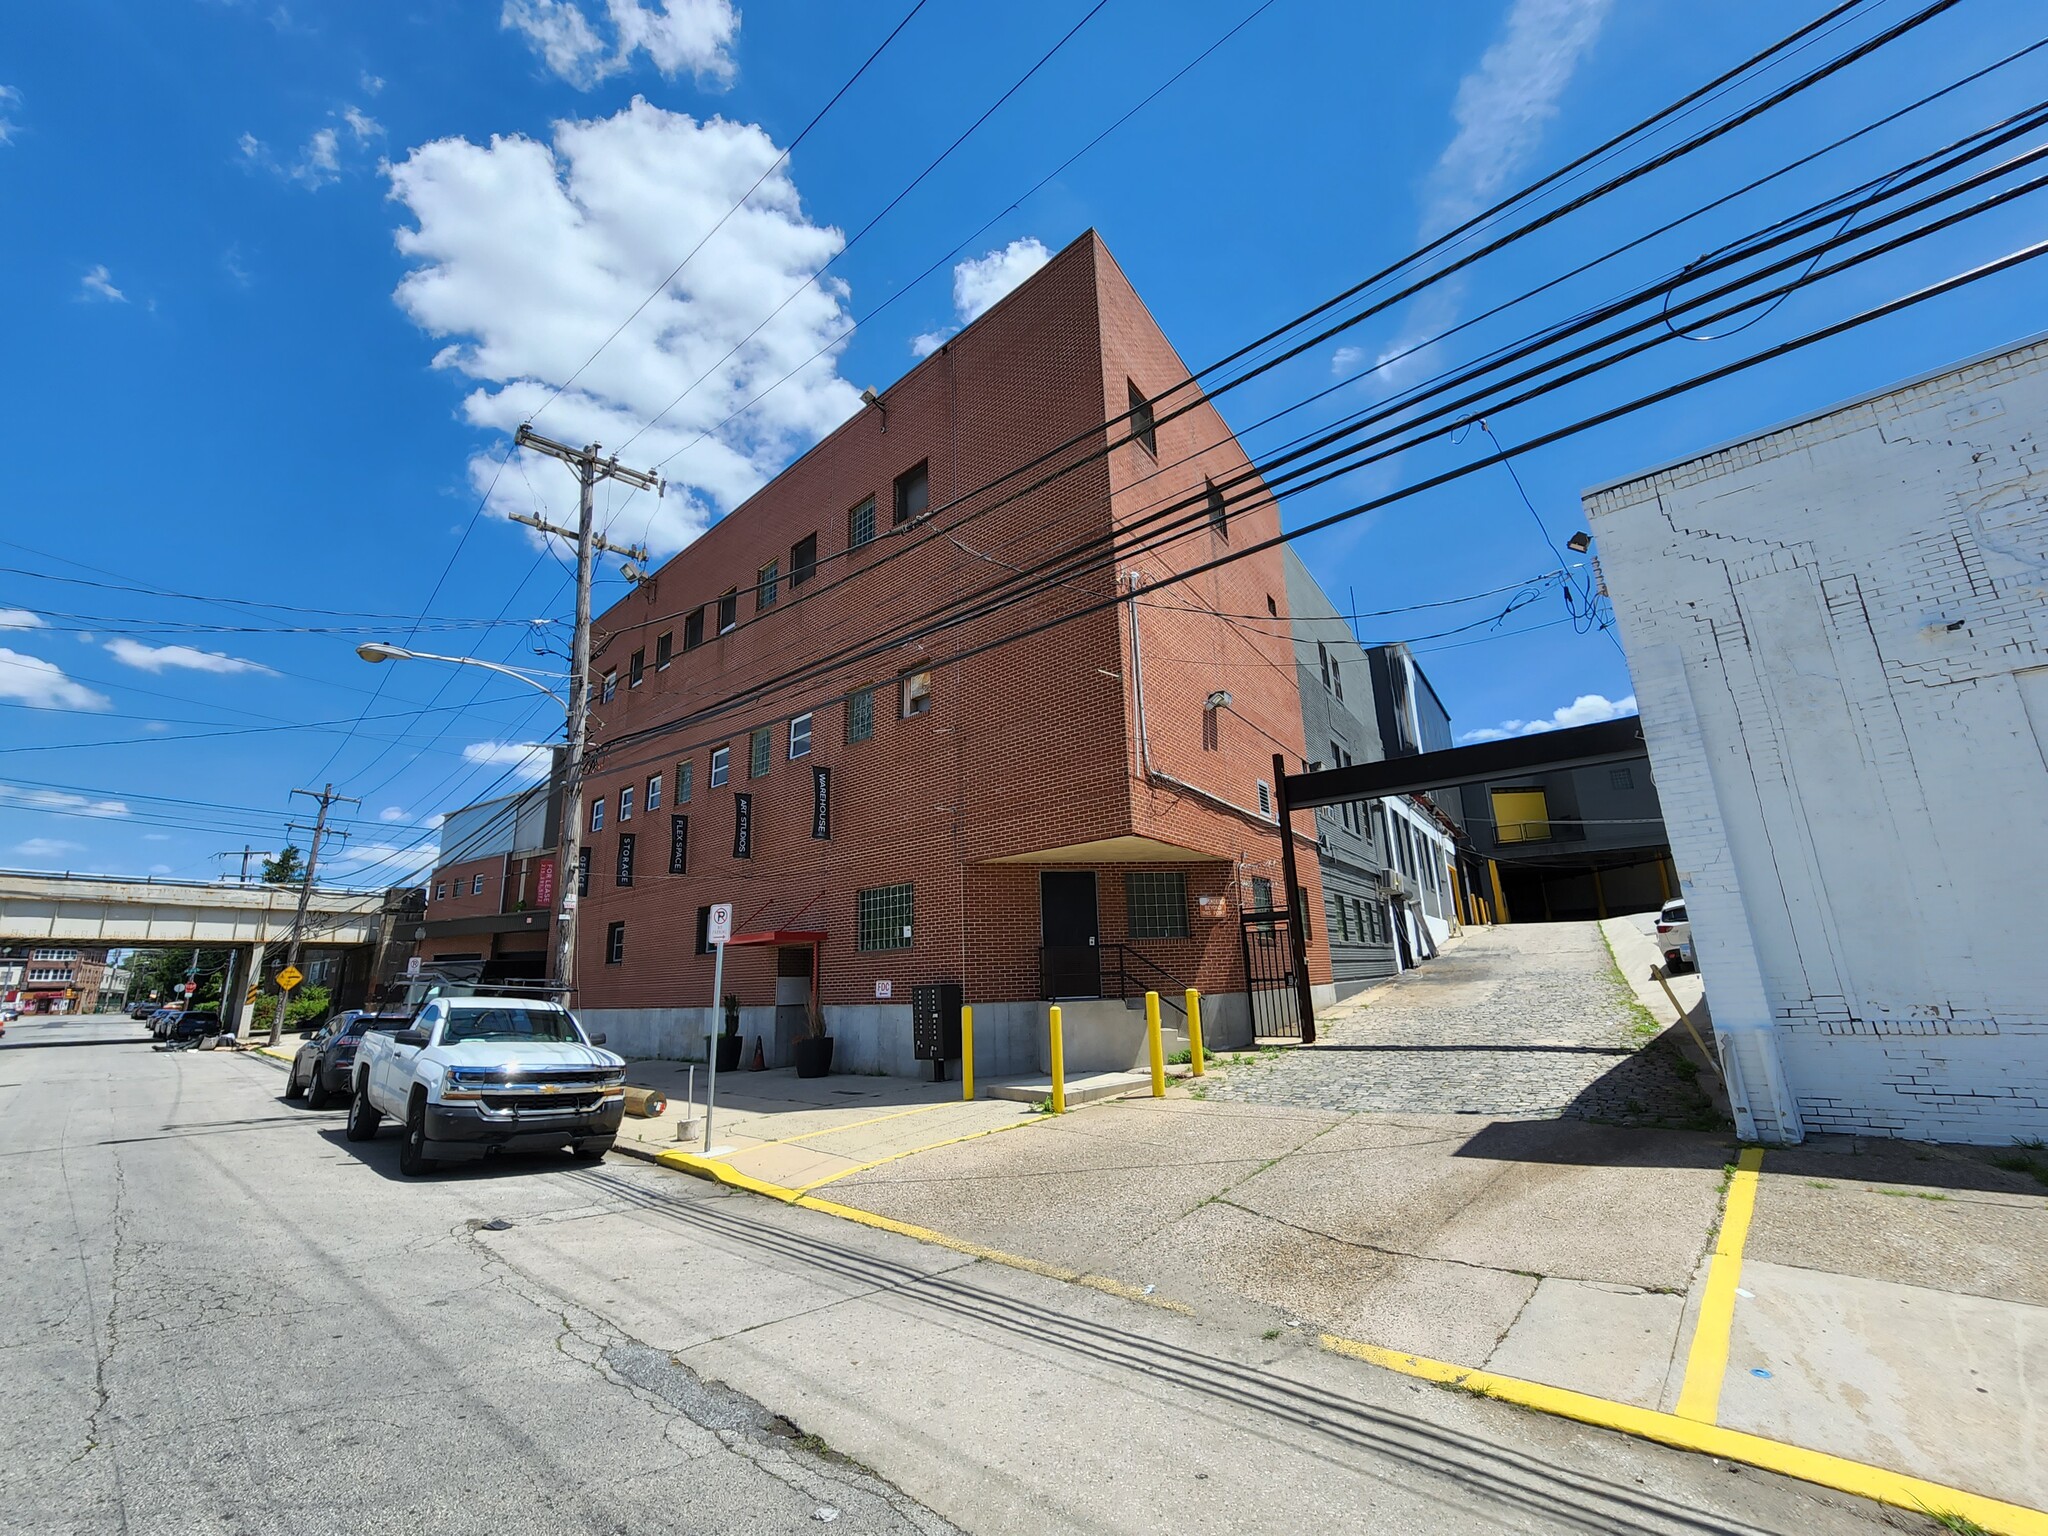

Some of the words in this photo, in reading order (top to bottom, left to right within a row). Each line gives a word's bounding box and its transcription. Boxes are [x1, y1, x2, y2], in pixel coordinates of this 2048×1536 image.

[740, 798, 748, 815] ART
[817, 773, 827, 833] WAREHOUSE
[676, 819, 684, 841] FLEX
[738, 816, 747, 853] STUDIOS
[621, 837, 631, 883] STORAGE
[674, 842, 683, 869] SPACE
[578, 855, 587, 888] OFFICE
[544, 880, 552, 903] LEASE
[877, 982, 890, 992] FDC
